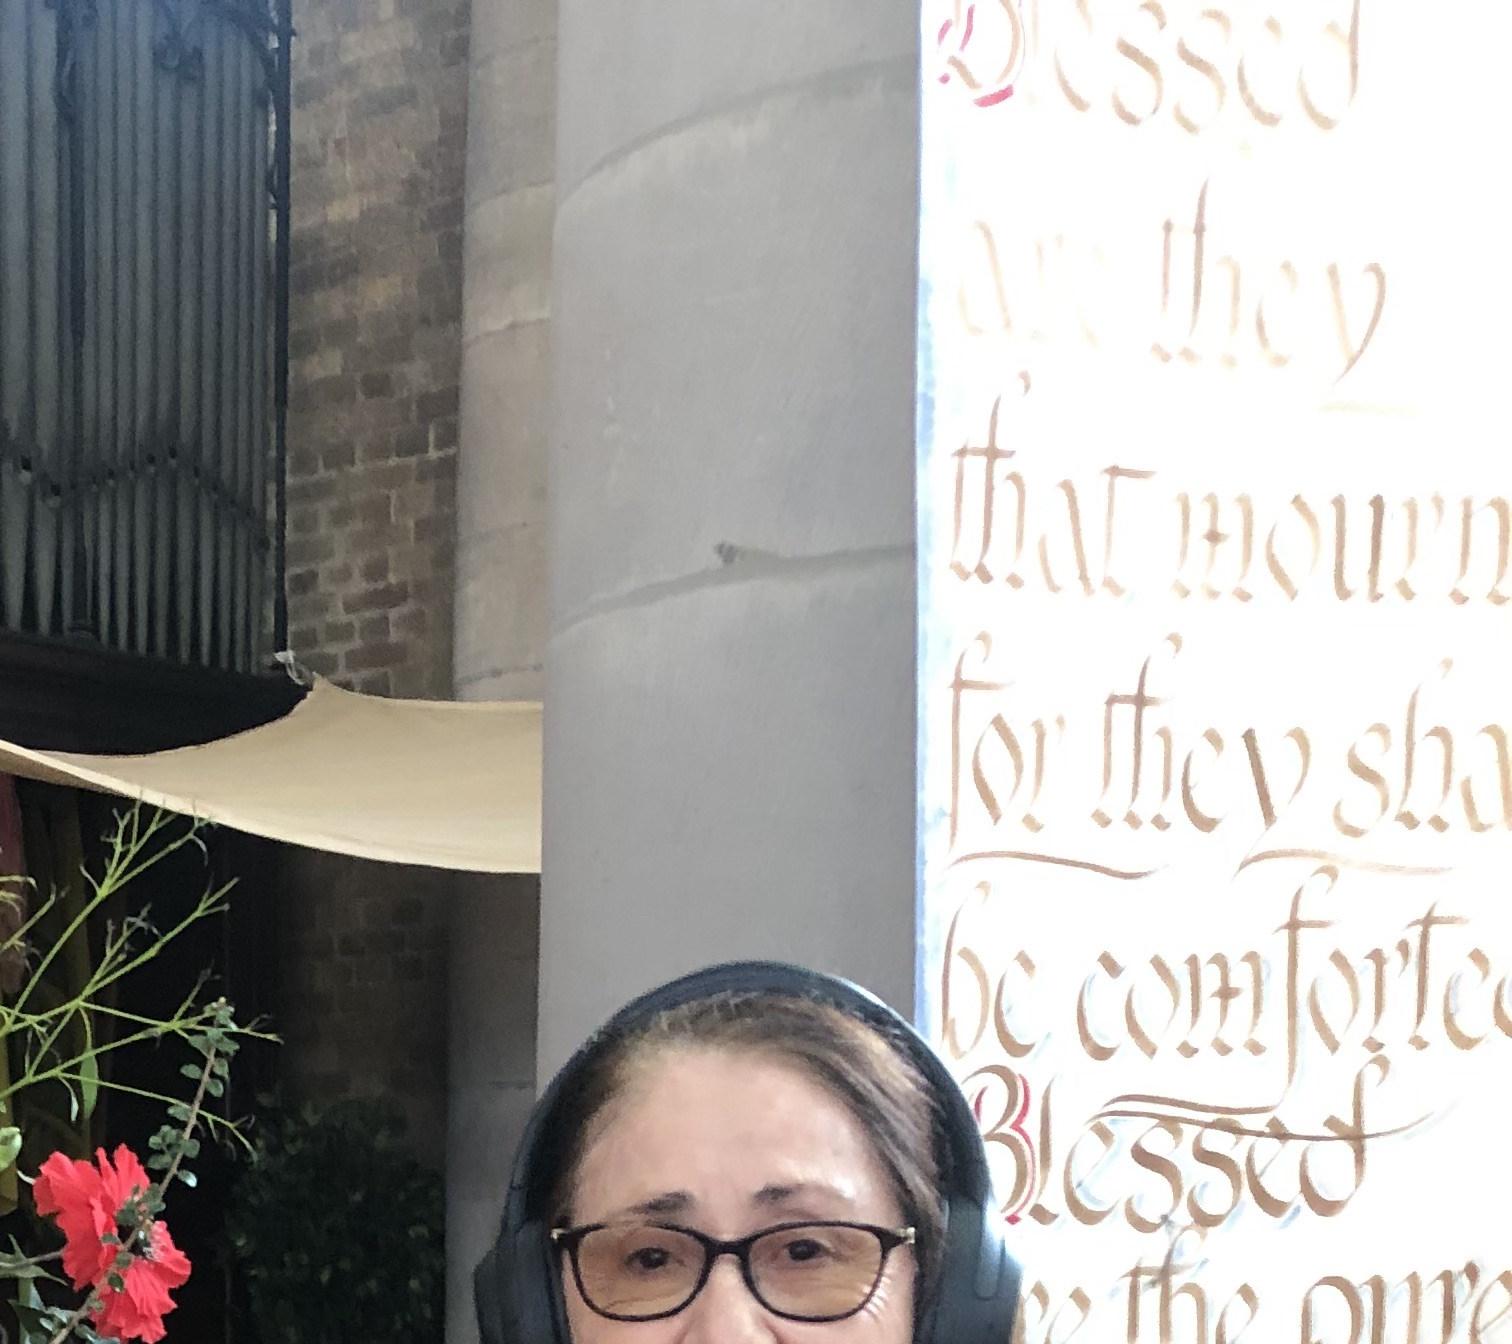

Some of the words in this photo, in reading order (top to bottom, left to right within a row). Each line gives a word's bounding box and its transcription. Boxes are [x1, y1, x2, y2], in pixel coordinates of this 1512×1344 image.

[1148, 175, 1386, 388] they
[949, 372, 1156, 597] that
[1171, 490, 1512, 606] mourn
[944, 631, 1088, 875] for
[1092, 632, 1328, 875] they
[941, 882, 1036, 1060] be
[960, 1060, 1393, 1234] Blessed
